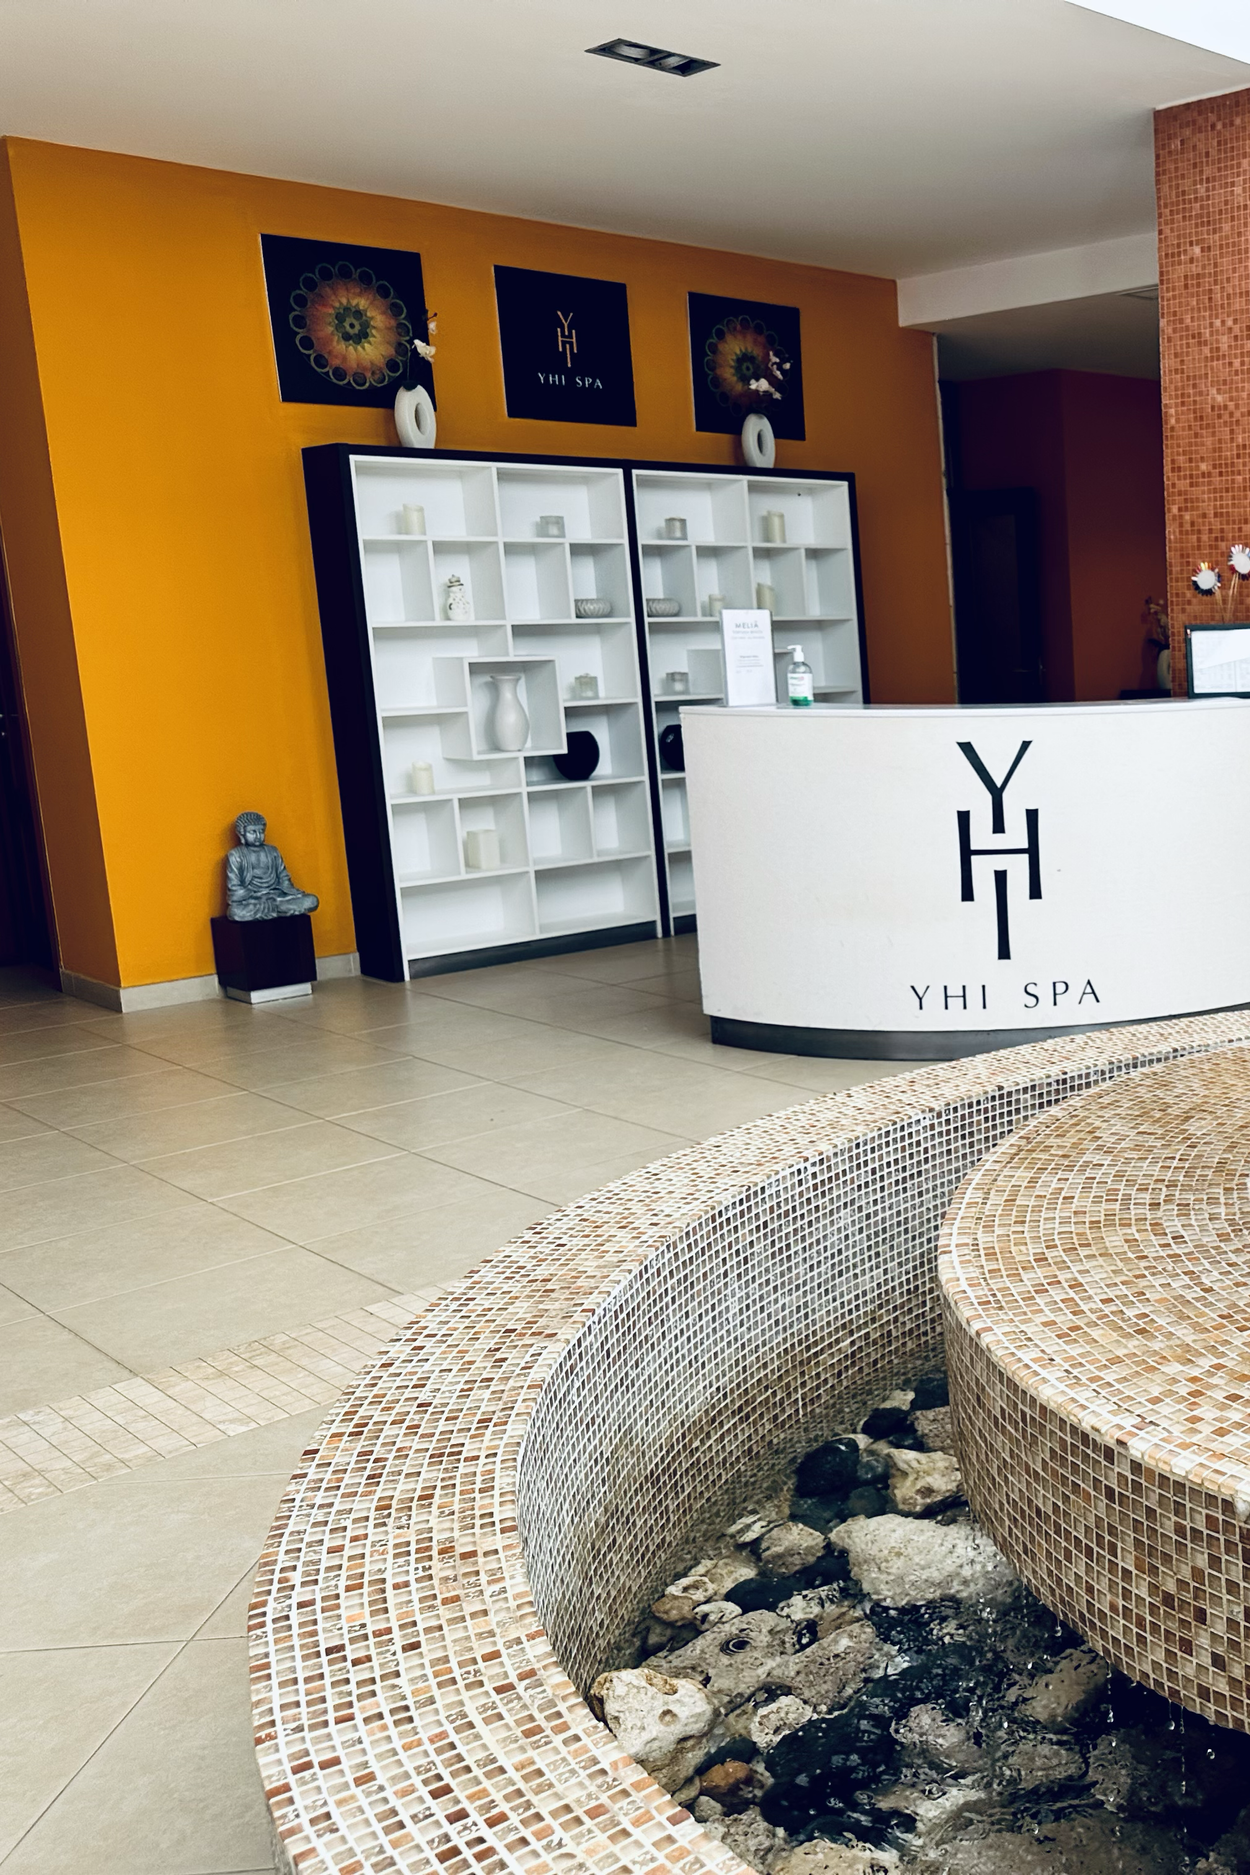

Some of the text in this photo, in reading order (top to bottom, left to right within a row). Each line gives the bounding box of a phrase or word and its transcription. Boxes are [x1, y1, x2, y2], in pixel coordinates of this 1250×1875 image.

[538, 372, 603, 389] YHI SPA
[909, 978, 1100, 1010] YHI SPA
